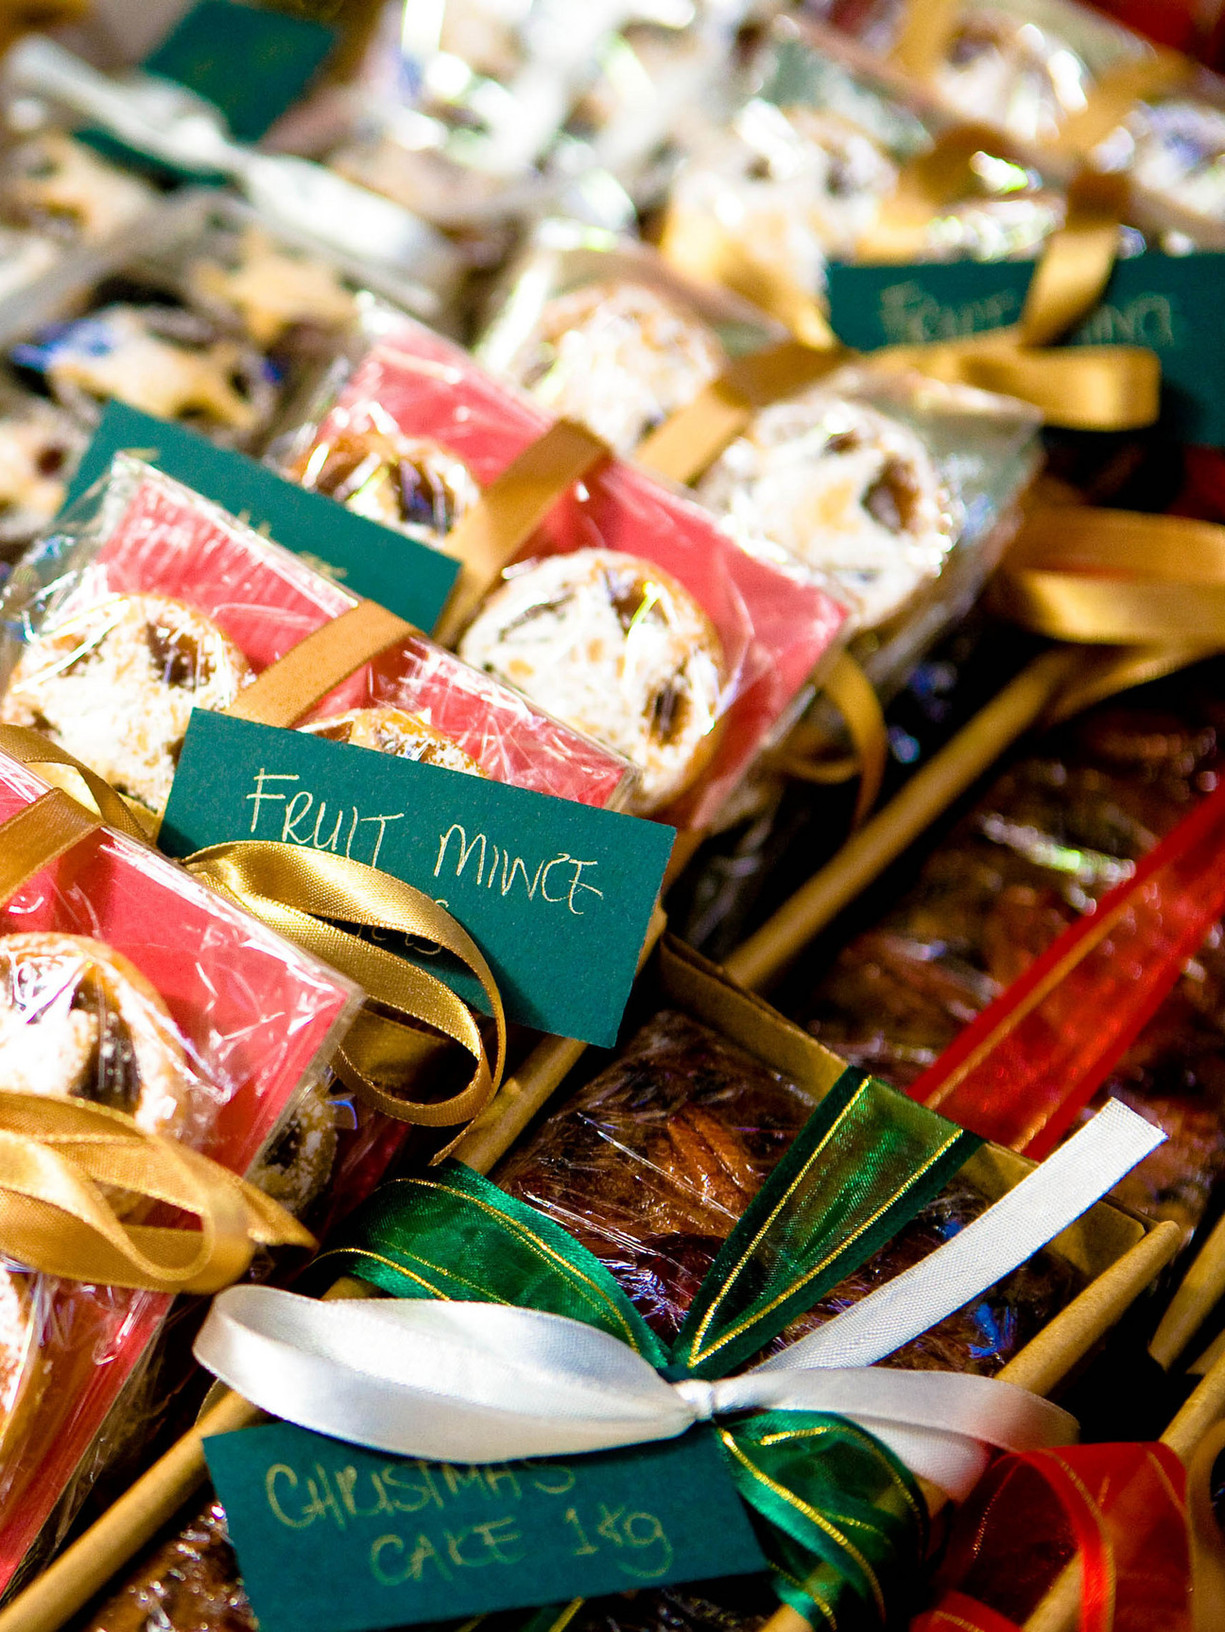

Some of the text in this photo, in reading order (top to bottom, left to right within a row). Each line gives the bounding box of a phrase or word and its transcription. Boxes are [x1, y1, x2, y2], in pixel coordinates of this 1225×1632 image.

[245, 767, 603, 915] FRUIT MINCE
[369, 1516, 524, 1586] CAKE
